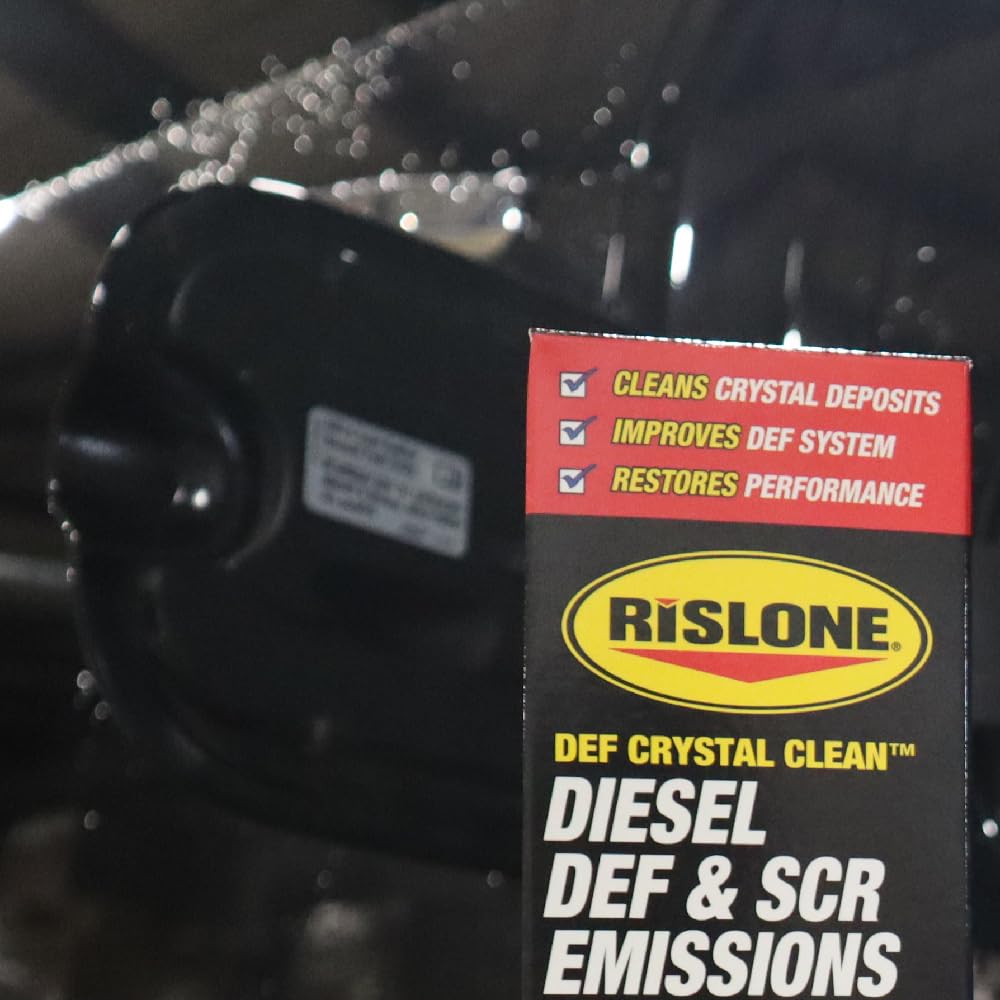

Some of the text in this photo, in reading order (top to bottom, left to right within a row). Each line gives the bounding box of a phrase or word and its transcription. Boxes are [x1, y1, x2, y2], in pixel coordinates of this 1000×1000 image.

[612, 370, 941, 416] CLEANS CRYSTAL DEPOSITS
[611, 418, 896, 459] IMPROVES DEF SYSTEM
[610, 466, 924, 507] RESTORES PERFORMANCE
[554, 732, 617, 764] DEF
[628, 736, 775, 767] CRYSTAL
[544, 777, 767, 845] DIESEL
[543, 853, 886, 922] DEF & SCR
[543, 929, 900, 997] EMISSIONS
